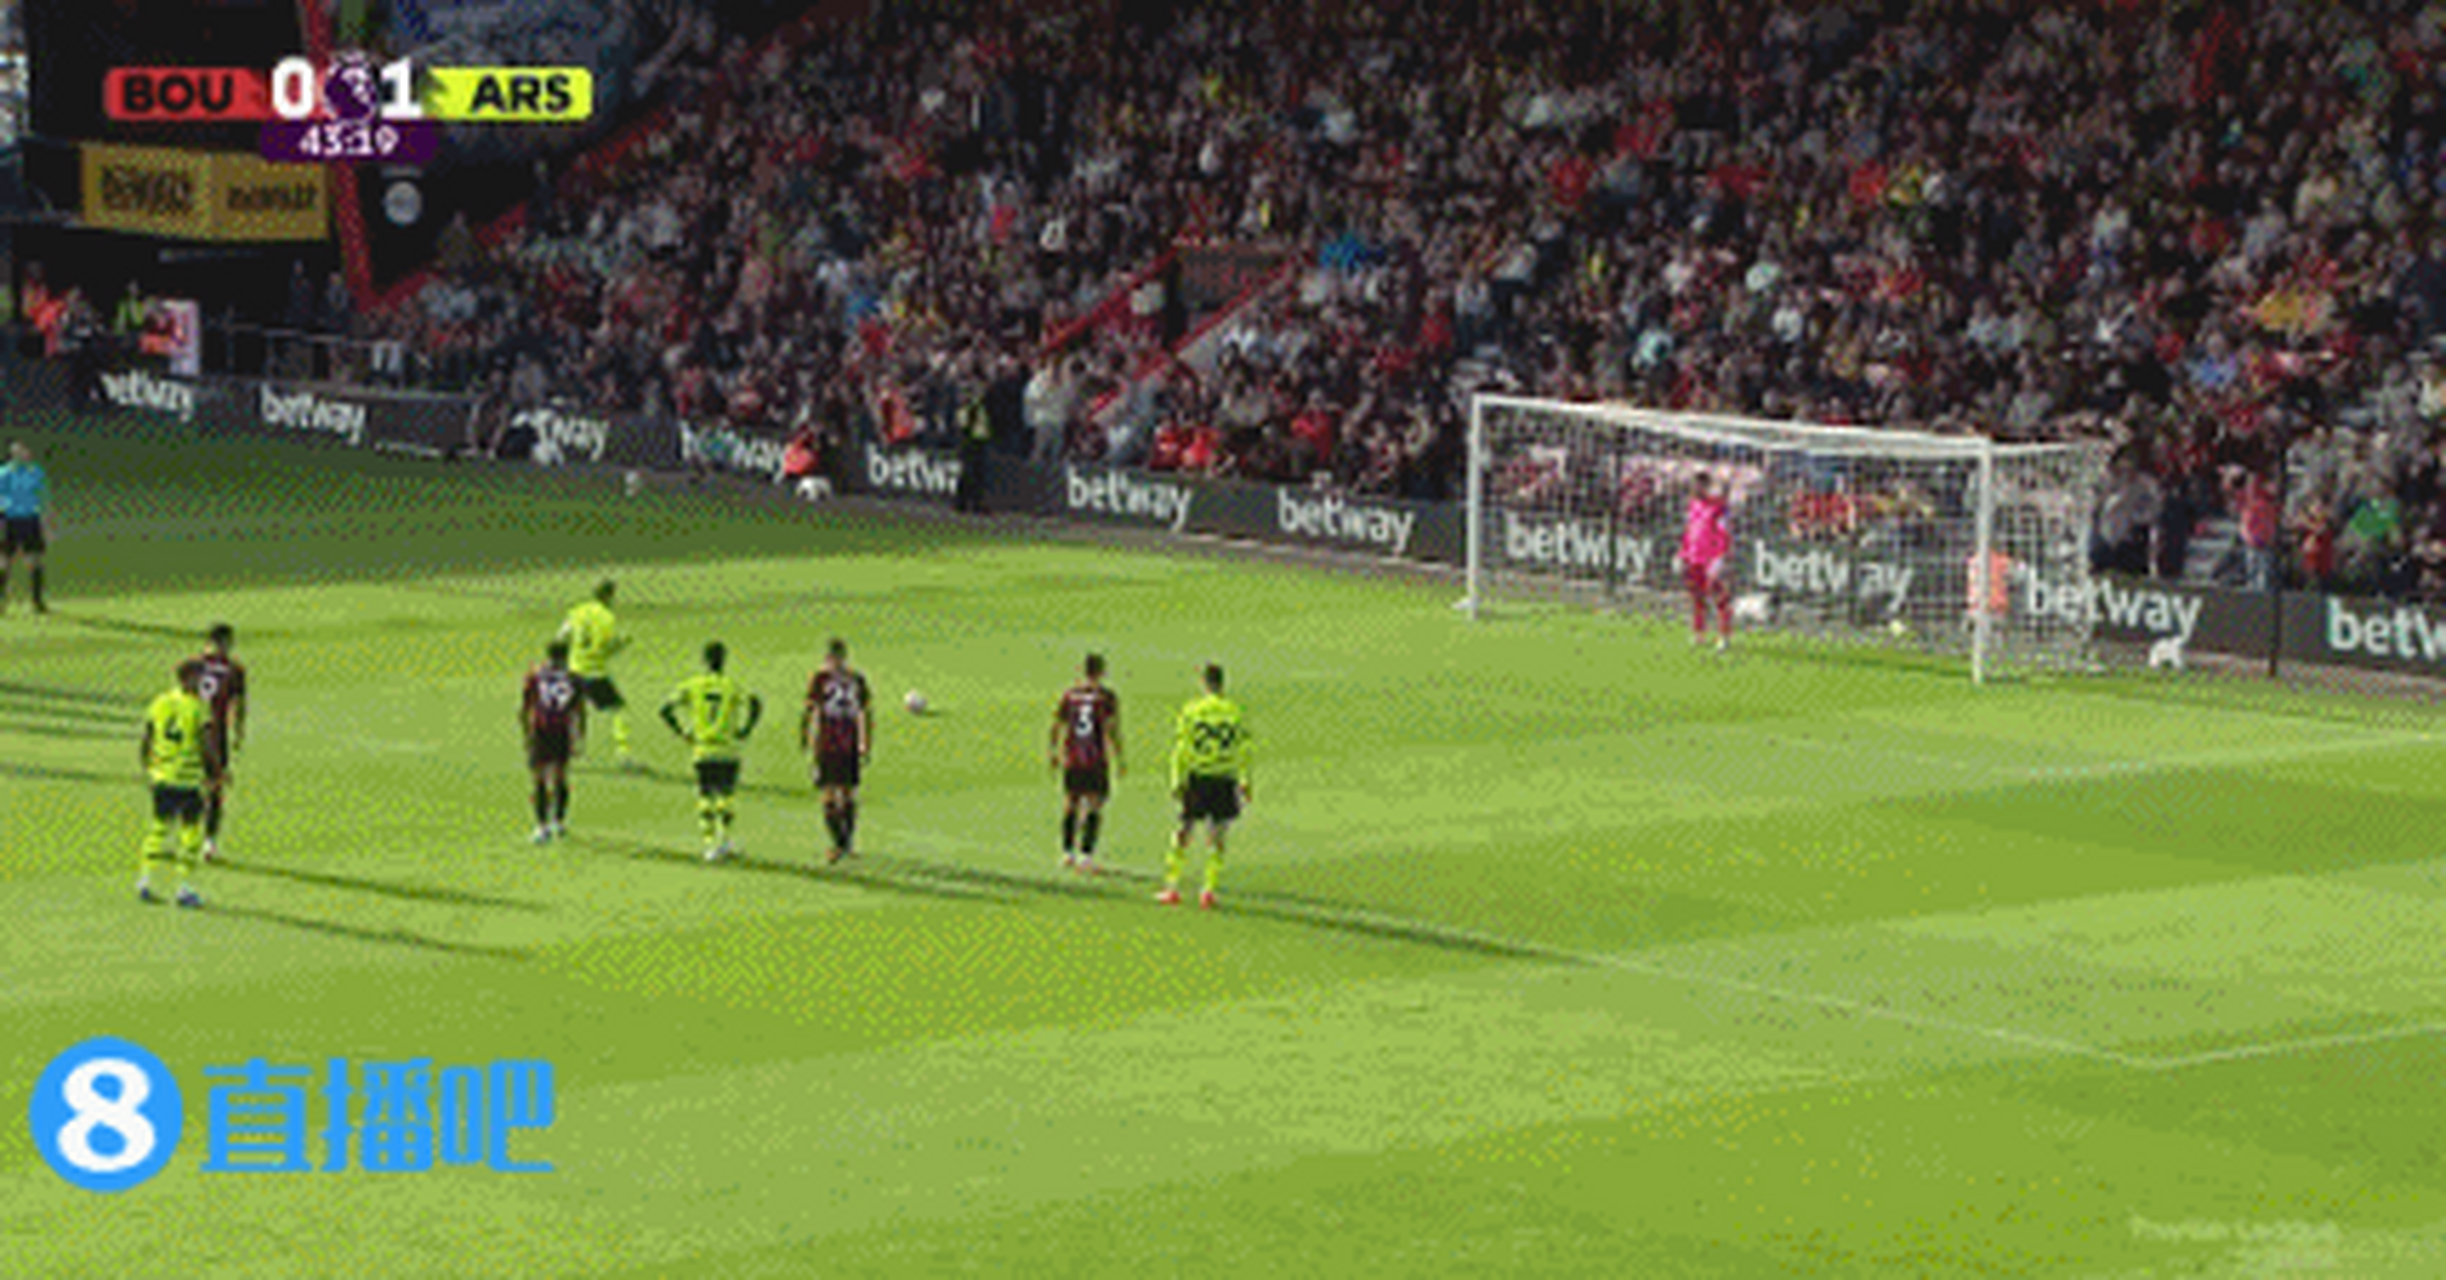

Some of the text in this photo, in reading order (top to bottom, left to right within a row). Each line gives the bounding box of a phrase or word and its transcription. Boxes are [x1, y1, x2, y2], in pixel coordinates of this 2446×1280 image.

[1067, 466, 1192, 532] betway
[1278, 486, 1414, 557] betway
[2028, 566, 2202, 642] betway
[163, 713, 184, 744] 4
[703, 691, 722, 722] 7
[1195, 719, 1236, 752] 29
